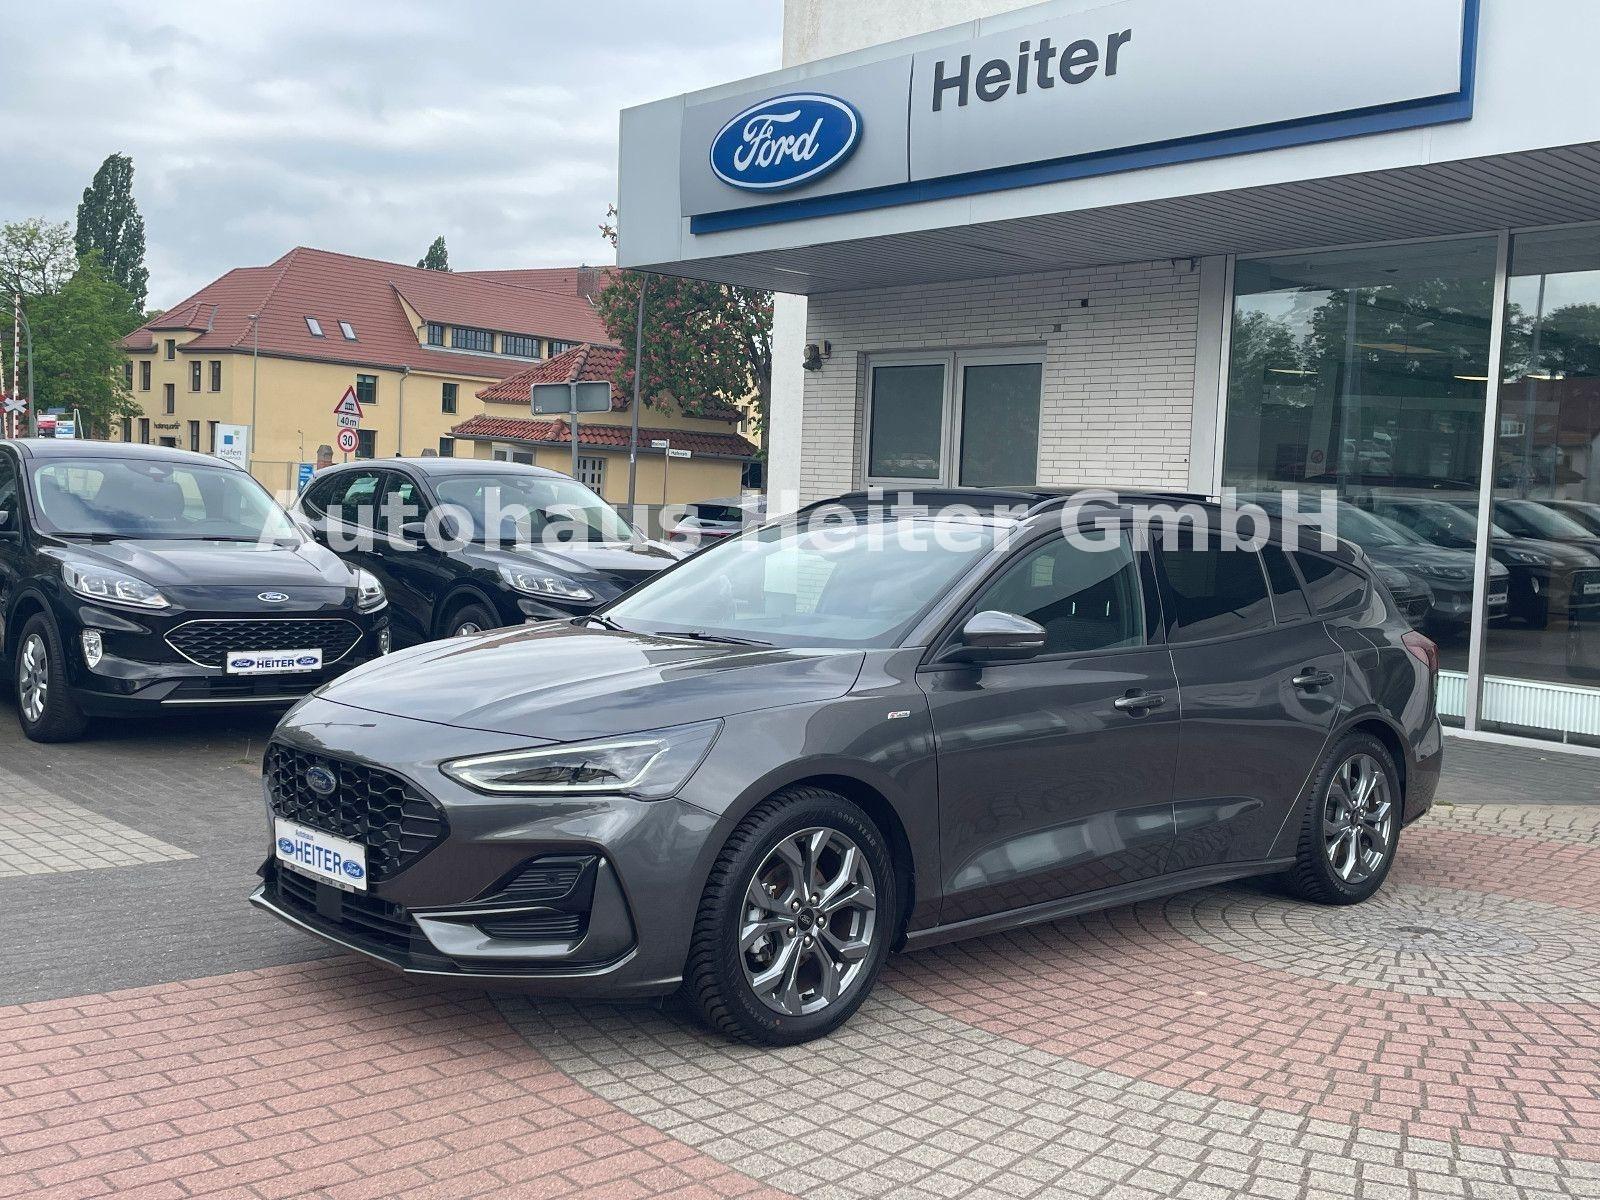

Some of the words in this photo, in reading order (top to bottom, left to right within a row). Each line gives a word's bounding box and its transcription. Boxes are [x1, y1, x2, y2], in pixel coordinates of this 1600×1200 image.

[931, 28, 1132, 113] Heiter
[733, 109, 824, 172] Ford
[220, 448, 242, 456] Hafen
[342, 434, 353, 447] 30
[256, 659, 295, 669] HEITER
[279, 839, 295, 854] Ford
[295, 839, 342, 876] HEITER
[346, 861, 362, 877] Ford
